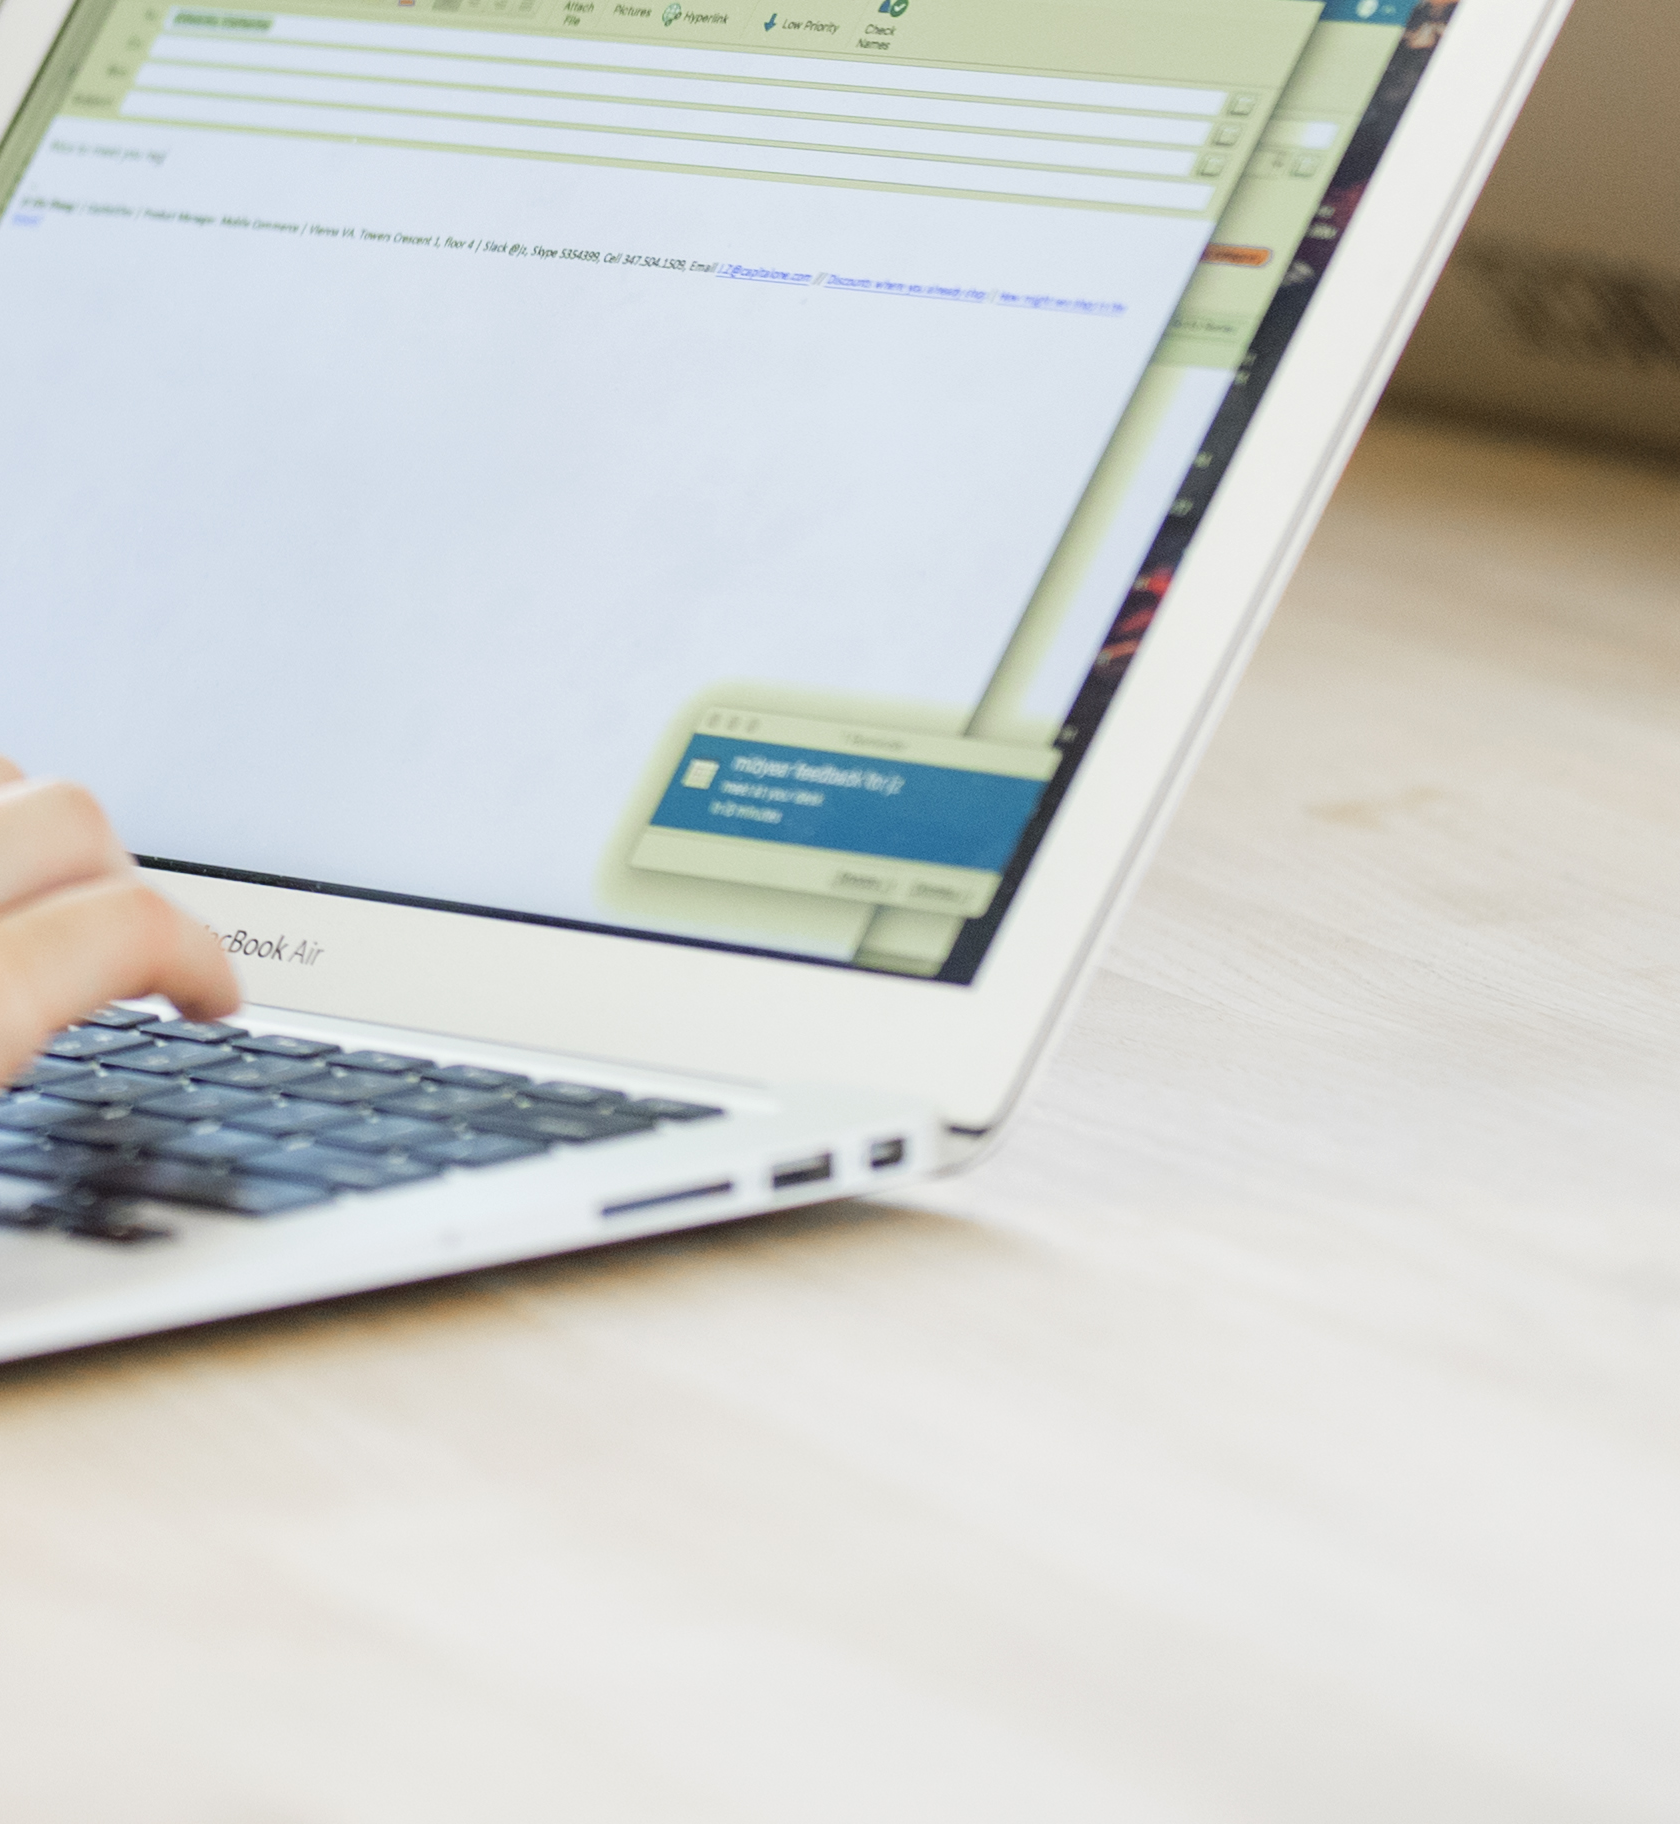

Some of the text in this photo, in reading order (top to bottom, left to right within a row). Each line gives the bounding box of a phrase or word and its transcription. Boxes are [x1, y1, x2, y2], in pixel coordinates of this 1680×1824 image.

[563, 1, 595, 14] Attach
[613, 4, 652, 19] Pictures
[683, 12, 730, 26] Hyperlink
[781, 20, 840, 35] Low Priority
[864, 23, 897, 37] Check
[855, 38, 891, 51] Names
[360, 228, 391, 243] Towers
[393, 232, 433, 246] Crescent
[444, 236, 467, 250] floor
[466, 239, 476, 250] 4
[483, 240, 508, 254] Slack
[531, 245, 558, 260] Skype
[603, 252, 622, 264] Cell
[204, 925, 325, 967] cBook Air
